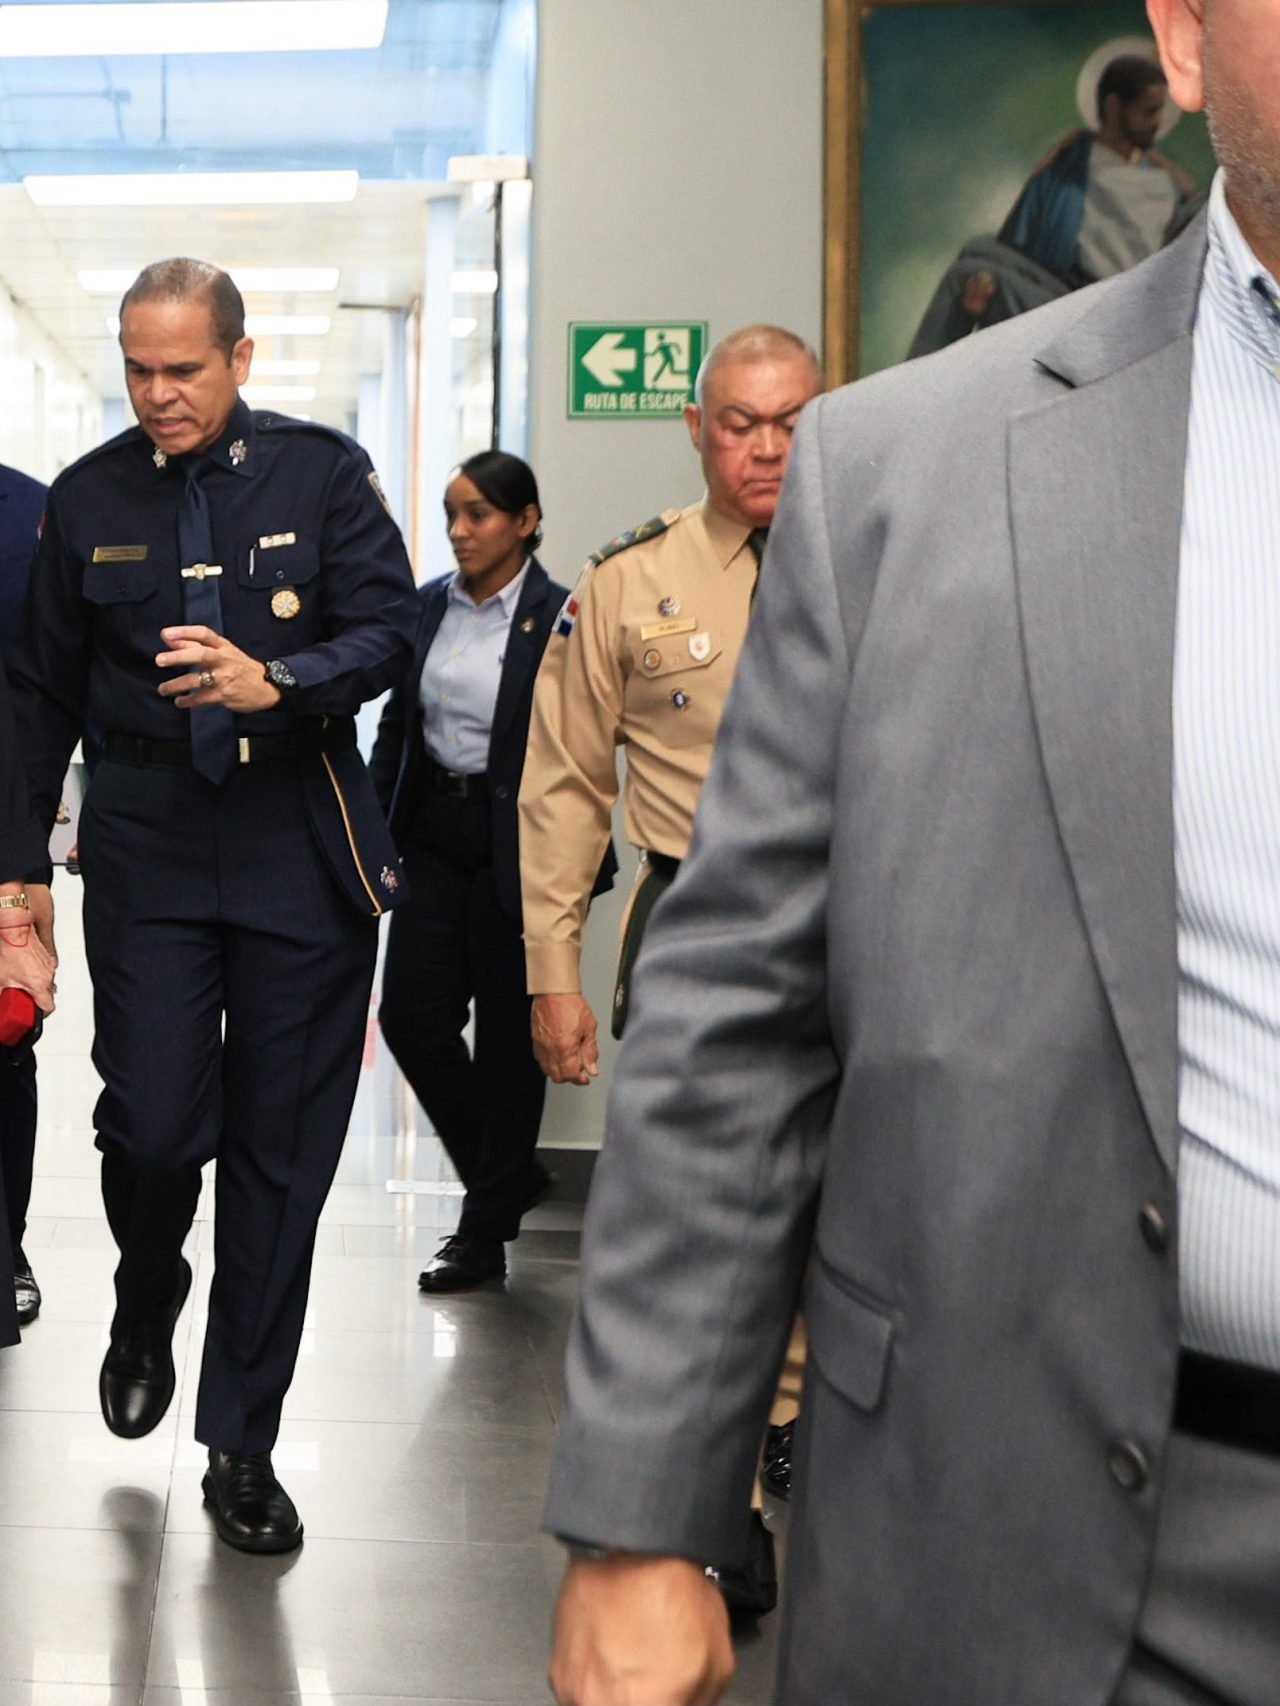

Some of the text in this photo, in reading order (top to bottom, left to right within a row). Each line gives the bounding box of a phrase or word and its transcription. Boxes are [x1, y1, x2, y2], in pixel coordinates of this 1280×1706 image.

[584, 393, 688, 409] RUTA DE ESCAPE
